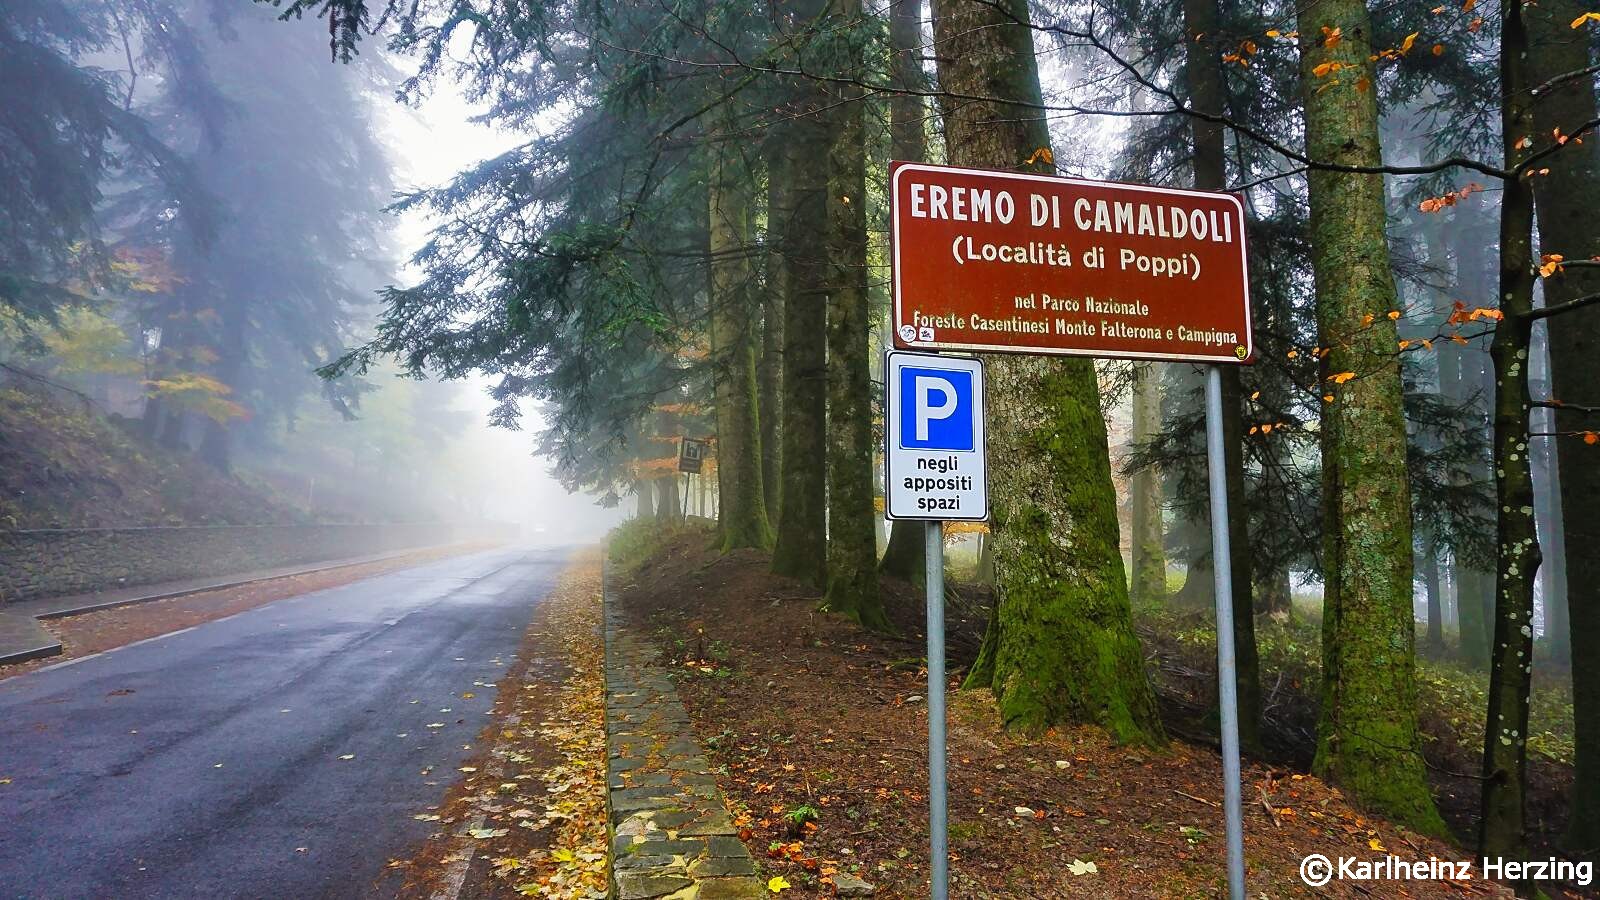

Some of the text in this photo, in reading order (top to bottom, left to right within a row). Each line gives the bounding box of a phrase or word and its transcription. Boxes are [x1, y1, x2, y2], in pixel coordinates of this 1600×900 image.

[911, 184, 1232, 243] EREMO DI CAMALDOLI
[952, 235, 1201, 281] (Località di Poppi)
[1015, 293, 1149, 316] nel Parco Nazionale
[913, 311, 1238, 347] Foreste Casentinesi Monte Falterona e Campigna
[916, 376, 958, 441] P
[917, 456, 958, 473] negli
[904, 476, 972, 492] appositi
[918, 495, 960, 512] spazi
